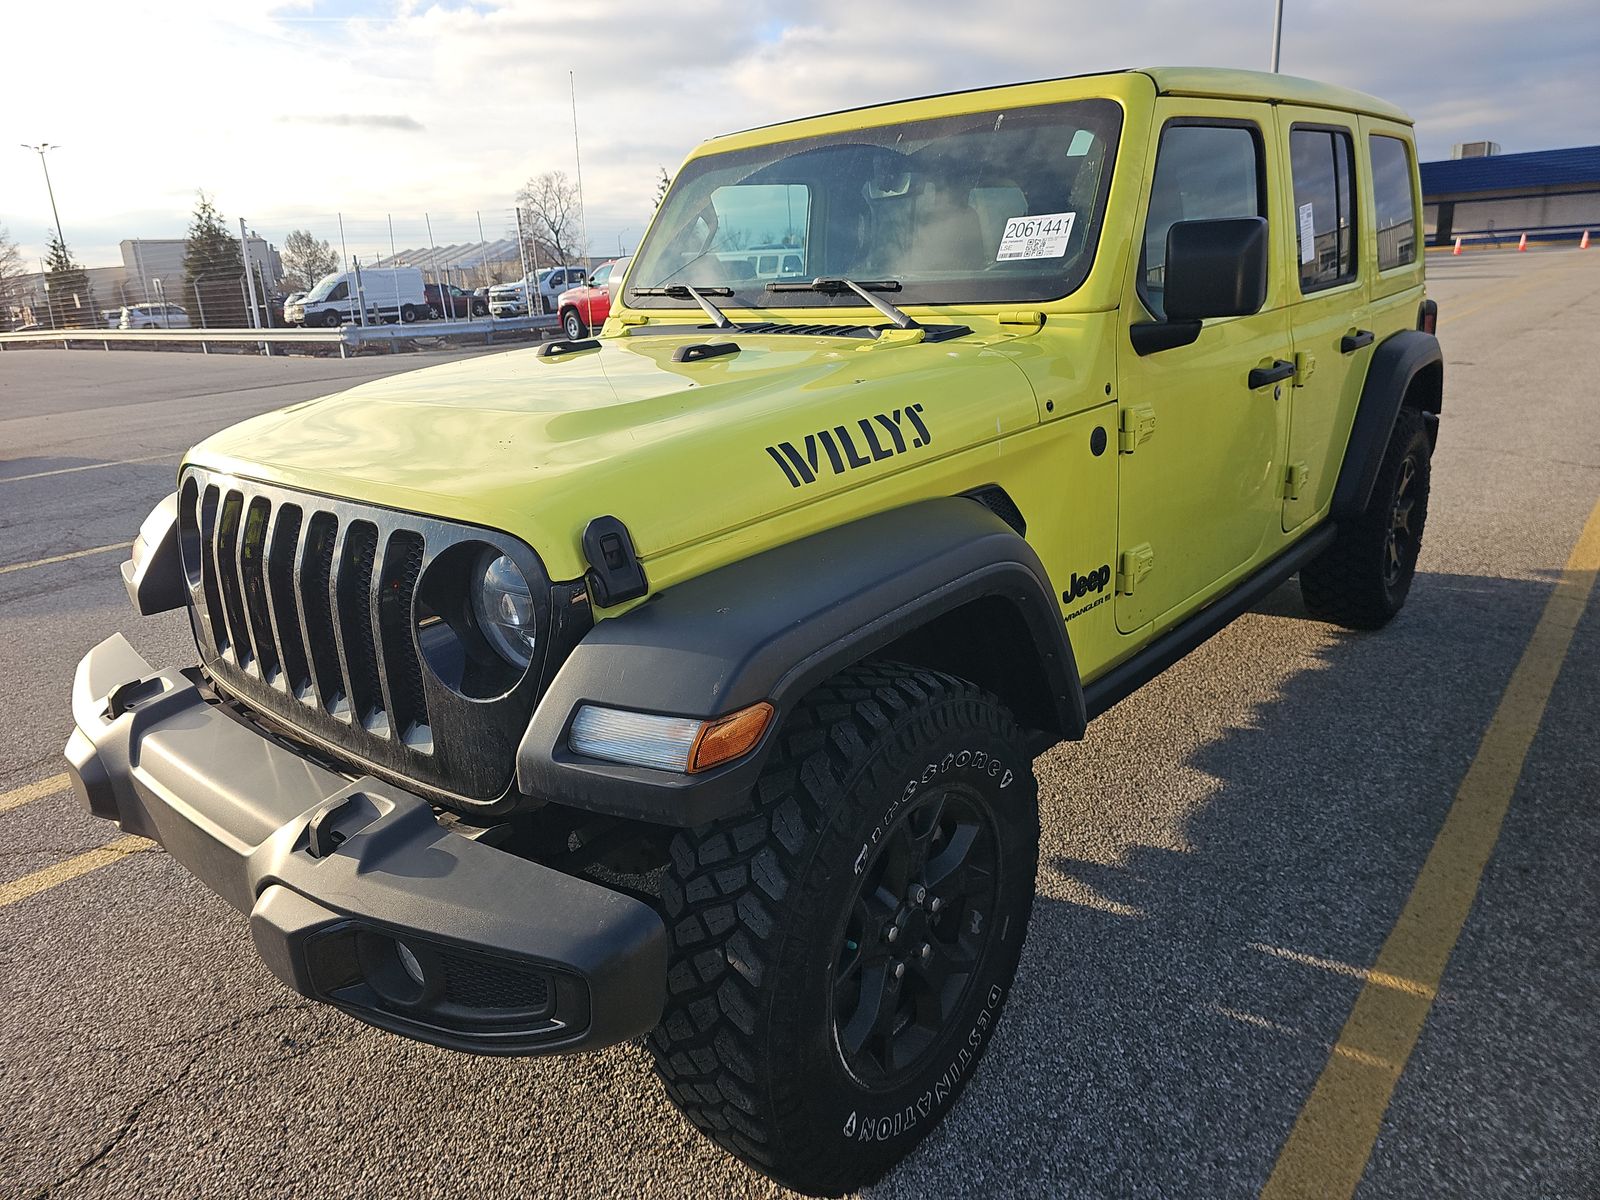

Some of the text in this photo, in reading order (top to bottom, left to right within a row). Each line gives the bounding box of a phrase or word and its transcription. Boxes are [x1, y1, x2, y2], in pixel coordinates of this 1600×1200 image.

[1005, 217, 1071, 239] 2061441
[765, 403, 931, 488] WILLYS
[1062, 564, 1110, 604] Jeep
[854, 750, 1001, 876] Firestone
[858, 984, 1002, 1142] DESTINATION
